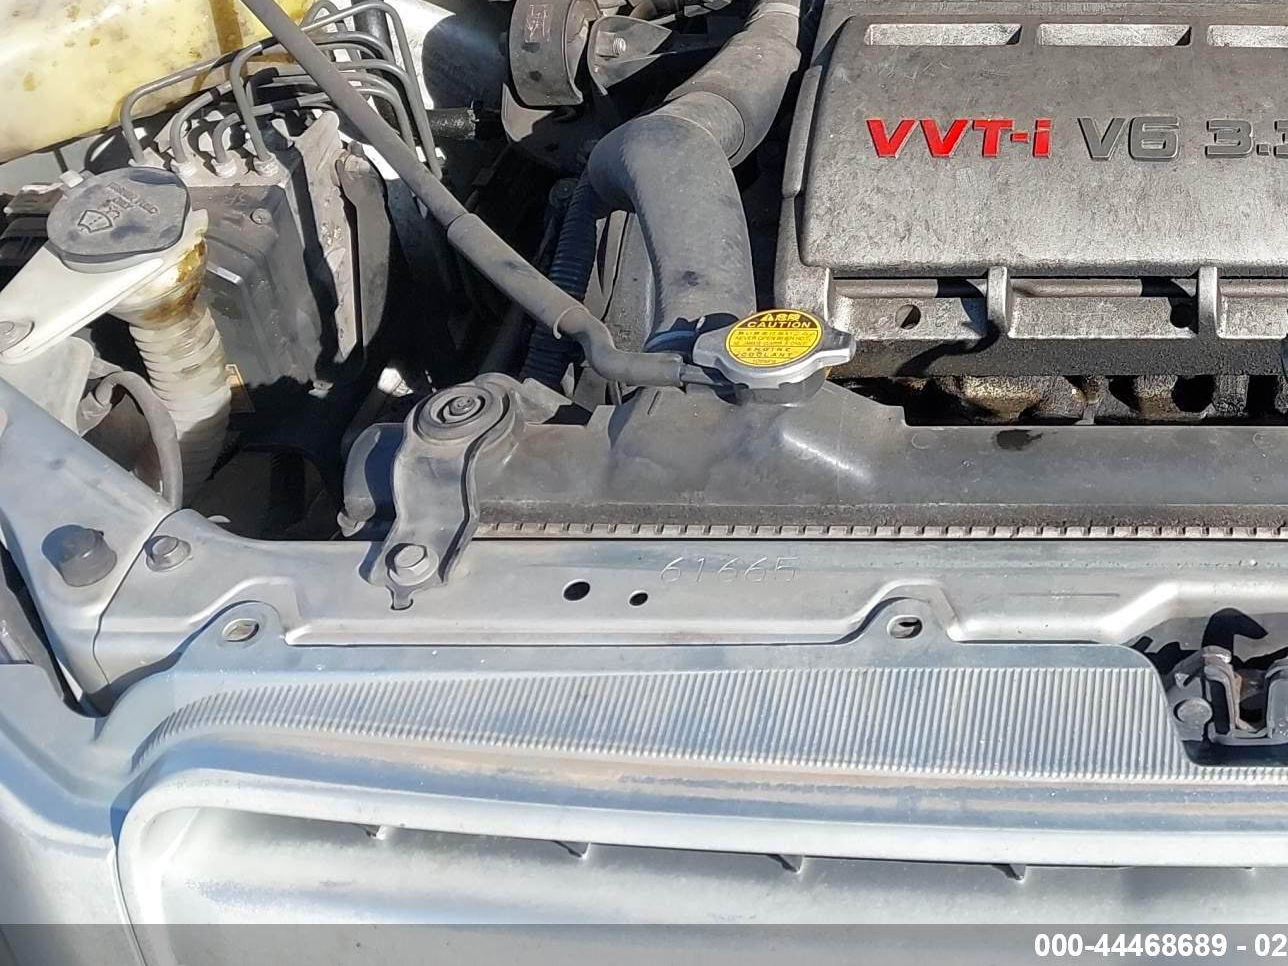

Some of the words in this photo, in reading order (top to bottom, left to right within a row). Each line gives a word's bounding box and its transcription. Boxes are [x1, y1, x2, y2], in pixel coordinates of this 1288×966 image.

[866, 118, 1053, 159] VVT-i
[1077, 117, 1180, 162] V6
[747, 321, 812, 329] CAUTION
[660, 556, 800, 583] 61665
